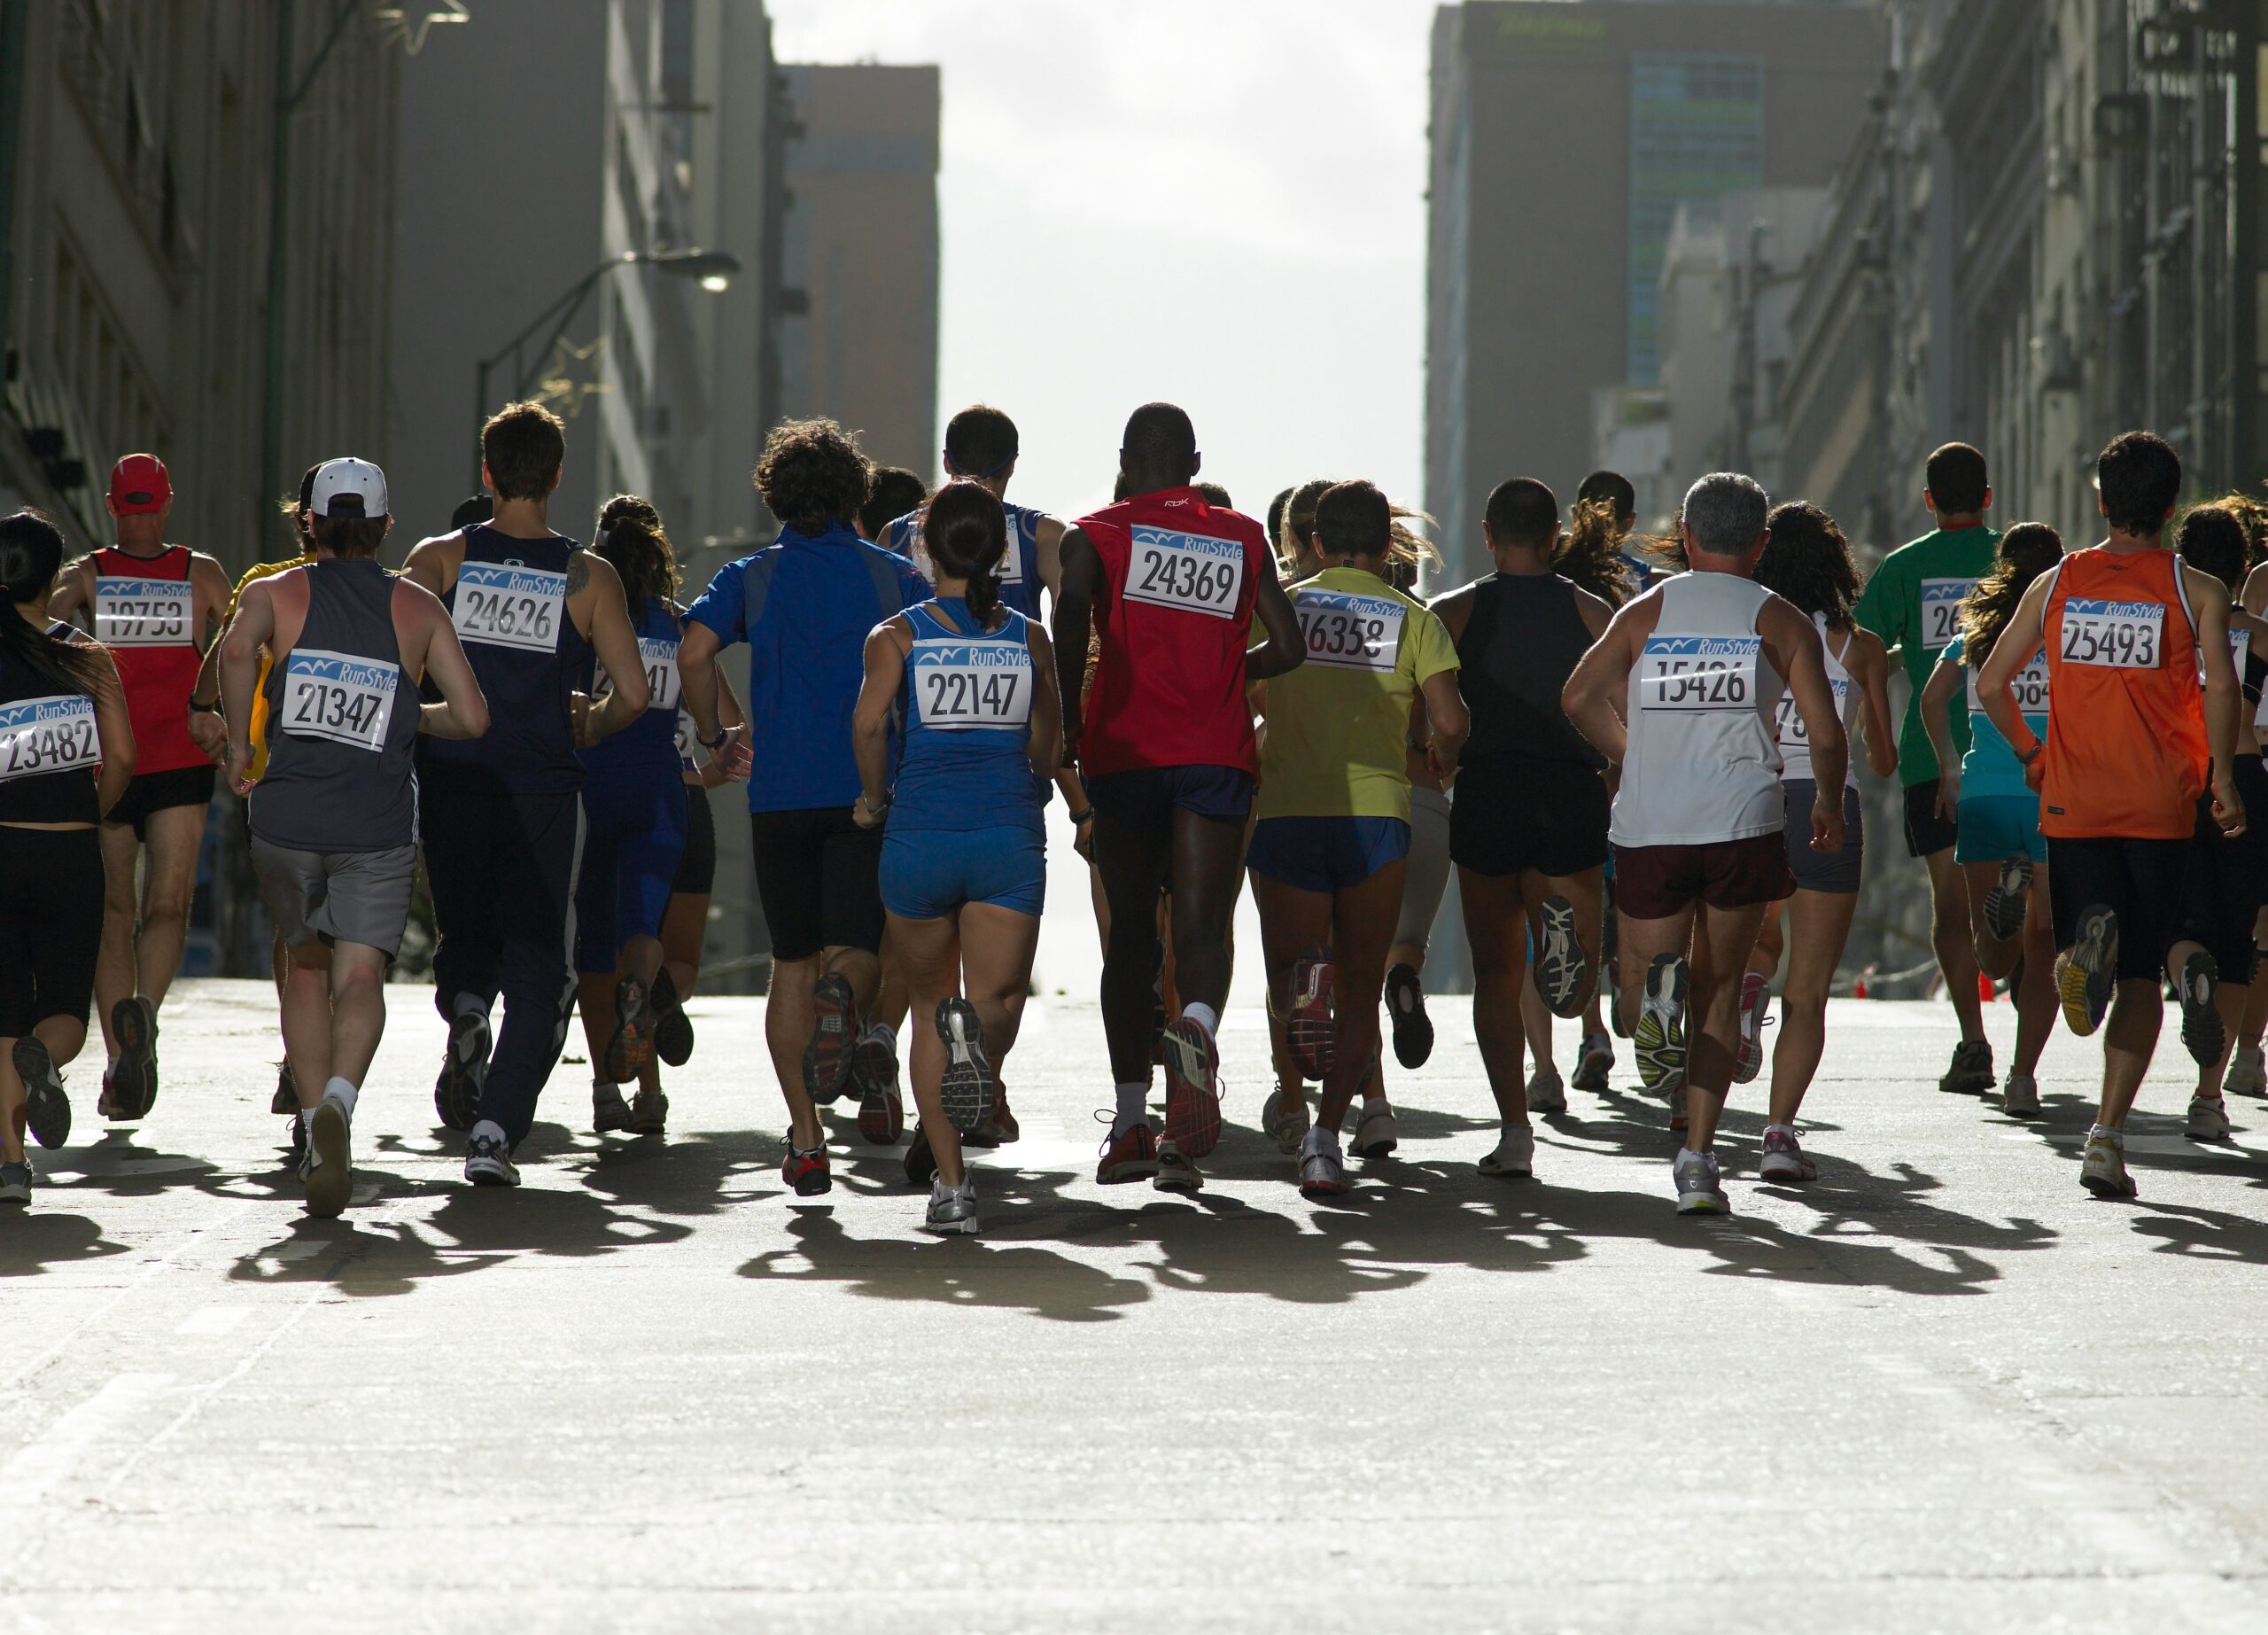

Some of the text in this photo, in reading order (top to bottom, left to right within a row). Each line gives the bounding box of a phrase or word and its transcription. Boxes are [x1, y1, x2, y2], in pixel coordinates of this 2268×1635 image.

[1184, 536, 1243, 560] RunStyle
[141, 582, 192, 597] RunStyle
[508, 572, 566, 596] RunStyle
[1139, 549, 1234, 603] 24369
[107, 601, 183, 636] 19753
[463, 590, 551, 640] 24626
[1347, 597, 1405, 618] RunStyle
[2104, 601, 2163, 619] RunStyle
[968, 647, 1031, 666] RunStyle
[1697, 638, 1759, 655] RunStyle
[2062, 619, 2154, 666] 25493
[338, 663, 398, 692] RunStyle
[1657, 660, 1745, 703] 15426
[293, 682, 383, 734] 21347
[928, 673, 1019, 716] 22147
[35, 698, 94, 721] RunStyle
[2, 720, 97, 773] 23482
